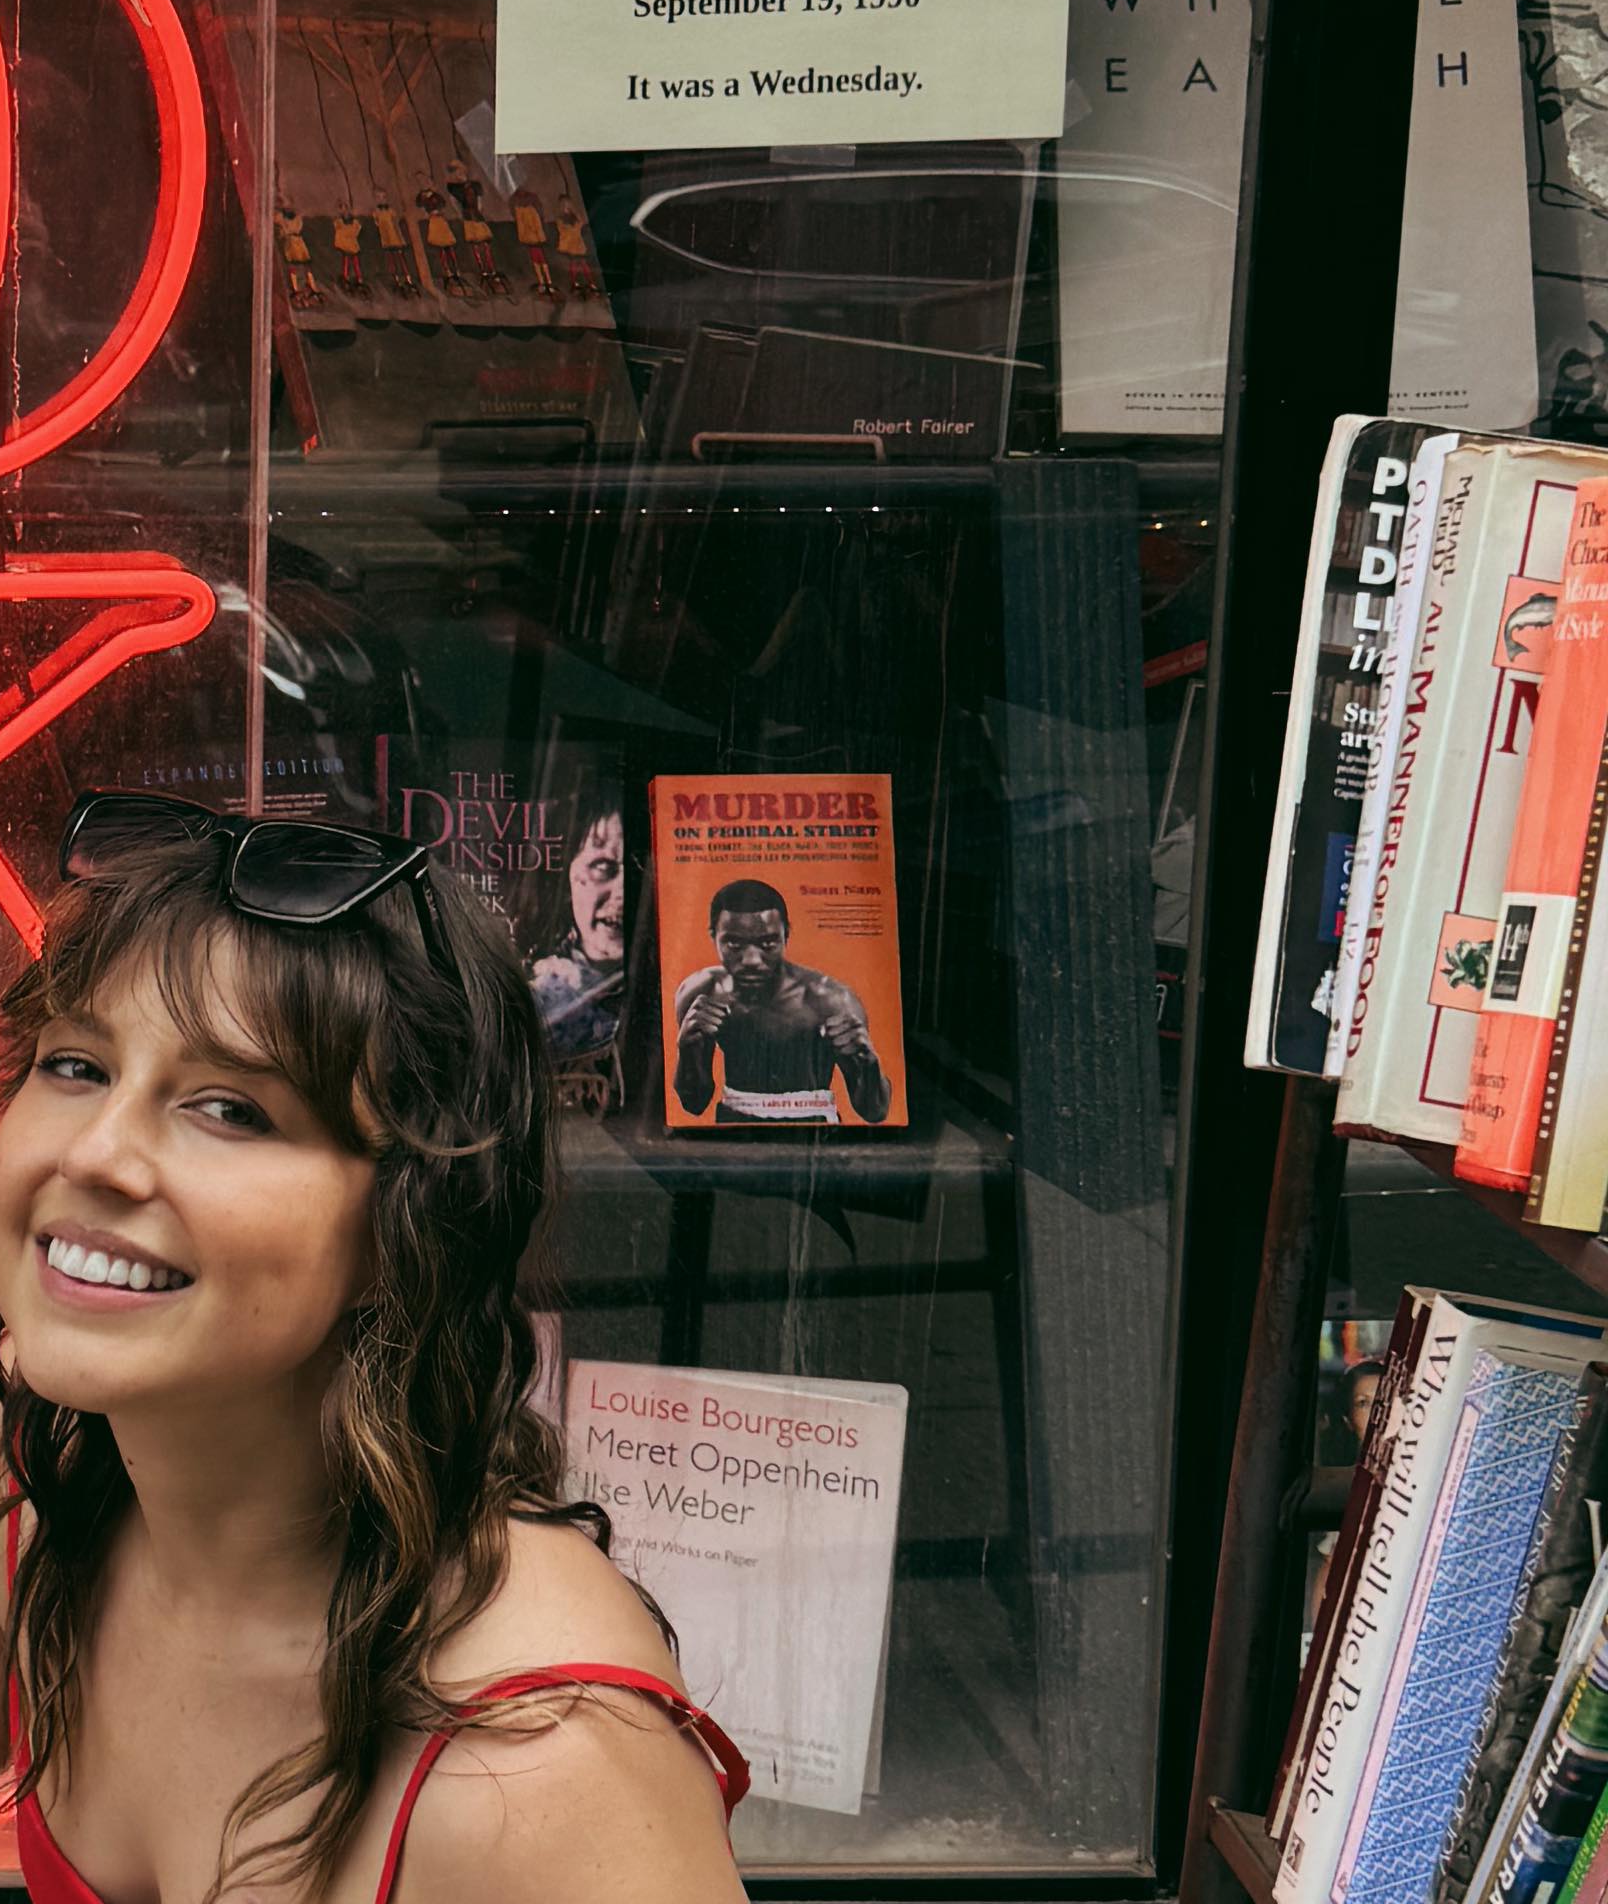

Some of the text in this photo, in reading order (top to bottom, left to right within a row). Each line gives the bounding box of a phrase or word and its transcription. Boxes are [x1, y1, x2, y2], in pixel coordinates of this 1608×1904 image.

[628, 64, 923, 100] It was a Wednesday.
[853, 417, 975, 437] Robert Fairer
[1399, 479, 1428, 588] OATH
[1432, 496, 1455, 572] FIELD
[1441, 475, 1473, 588] MICHAEL
[1580, 501, 1607, 529] The
[1364, 653, 1398, 794] HONOR
[143, 762, 248, 786] EXPANDE
[450, 771, 515, 800] THE
[673, 791, 880, 822] MURDER
[399, 787, 564, 848] DEVIL
[673, 824, 880, 840] ON FEDERAL STREET
[1347, 600, 1443, 1059] ALL MANNER OF FOOD
[449, 840, 565, 872] INSIDE
[1571, 780, 1608, 953] INVESTIGATION
[590, 1379, 859, 1448] Louise Bourgeois
[1409, 1335, 1457, 1428] Who
[587, 1425, 880, 1500] Meret Oppenheim
[1387, 1440, 1419, 1518] will
[644, 1480, 755, 1525] Weber
[662, 1540, 701, 1559] Works
[704, 1549, 720, 1561] on
[724, 1549, 759, 1568] Paper
[1365, 1521, 1395, 1595] tell
[1344, 1598, 1378, 1666] the
[1305, 1674, 1361, 1814] People
[1534, 1739, 1567, 1809] THE
